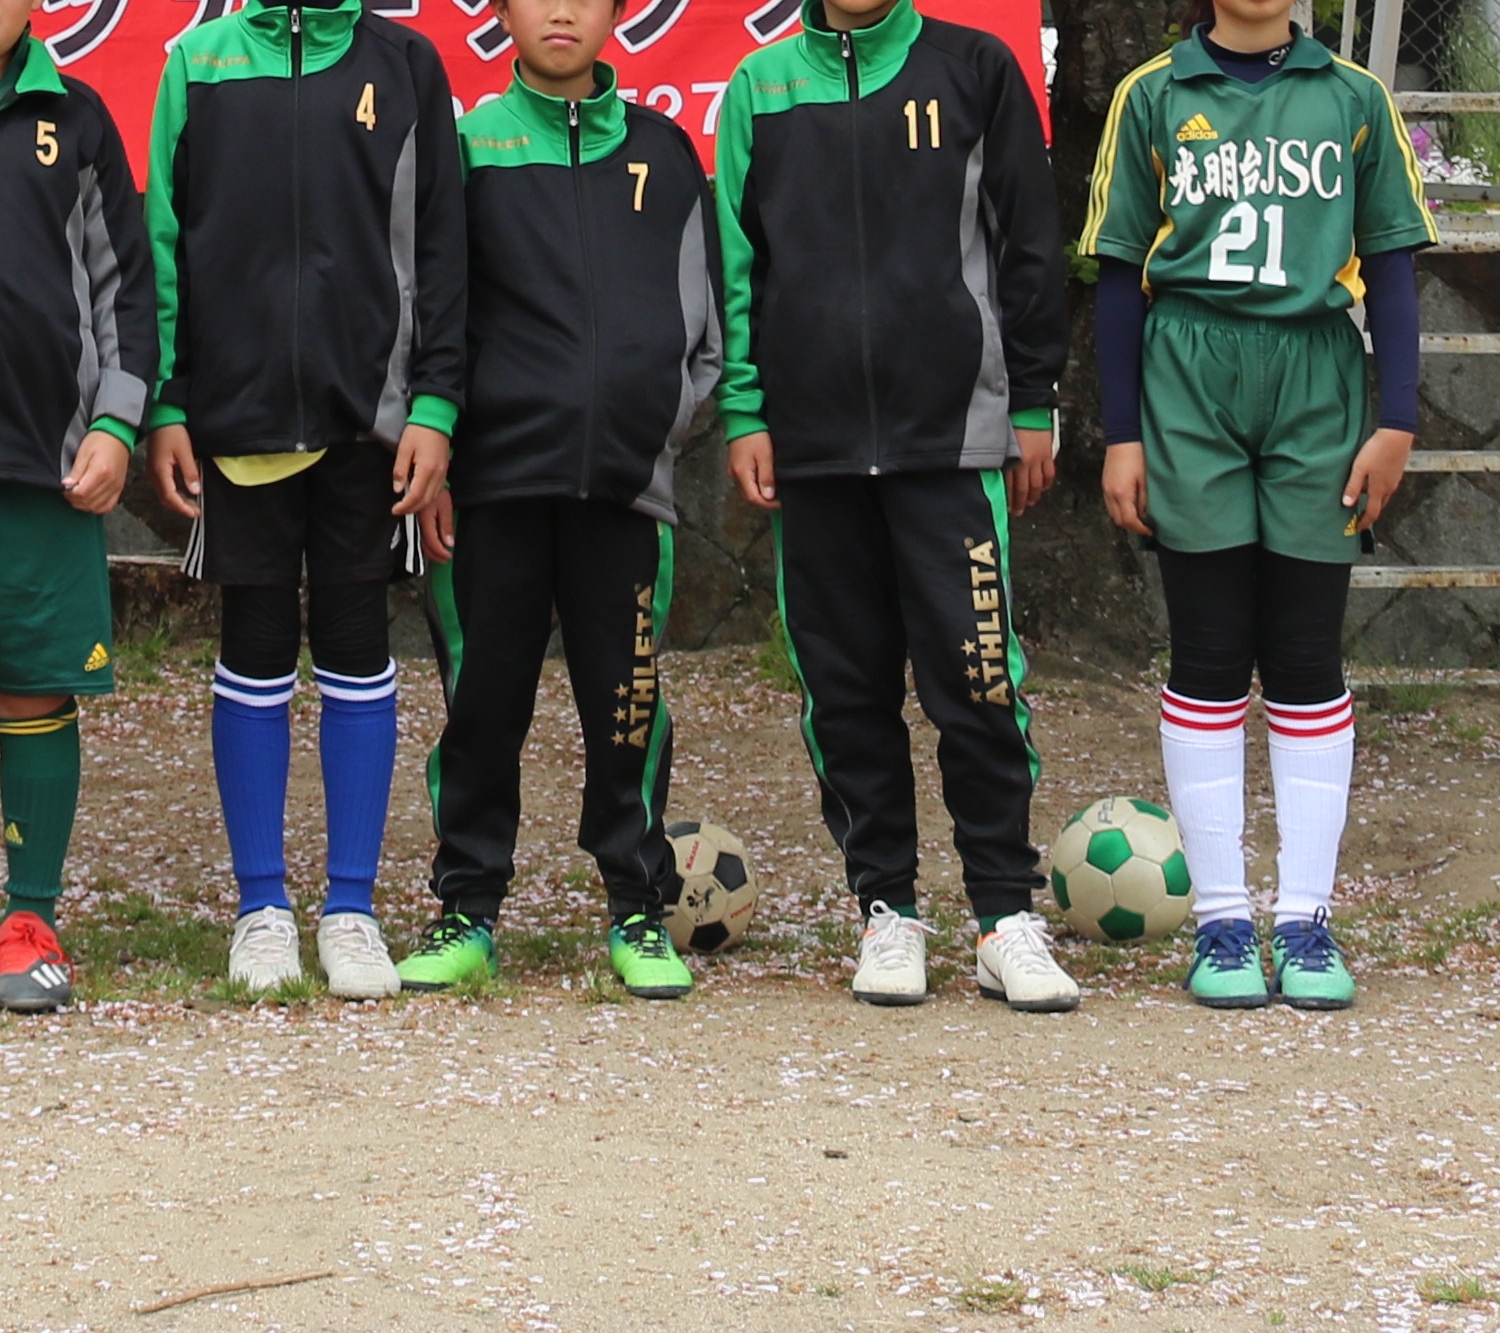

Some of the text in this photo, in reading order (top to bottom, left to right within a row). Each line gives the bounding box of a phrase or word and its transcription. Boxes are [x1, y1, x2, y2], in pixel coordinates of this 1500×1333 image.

[355, 82, 377, 132] 4
[902, 98, 941, 150] 11
[35, 119, 60, 167] 5
[1176, 129, 1218, 141] adidas
[626, 162, 650, 212] 7
[1168, 136, 1344, 208] 光明台JSC
[1208, 200, 1288, 288] 21
[968, 539, 1011, 708] ATHLETA
[627, 585, 657, 750] ATHLETA
